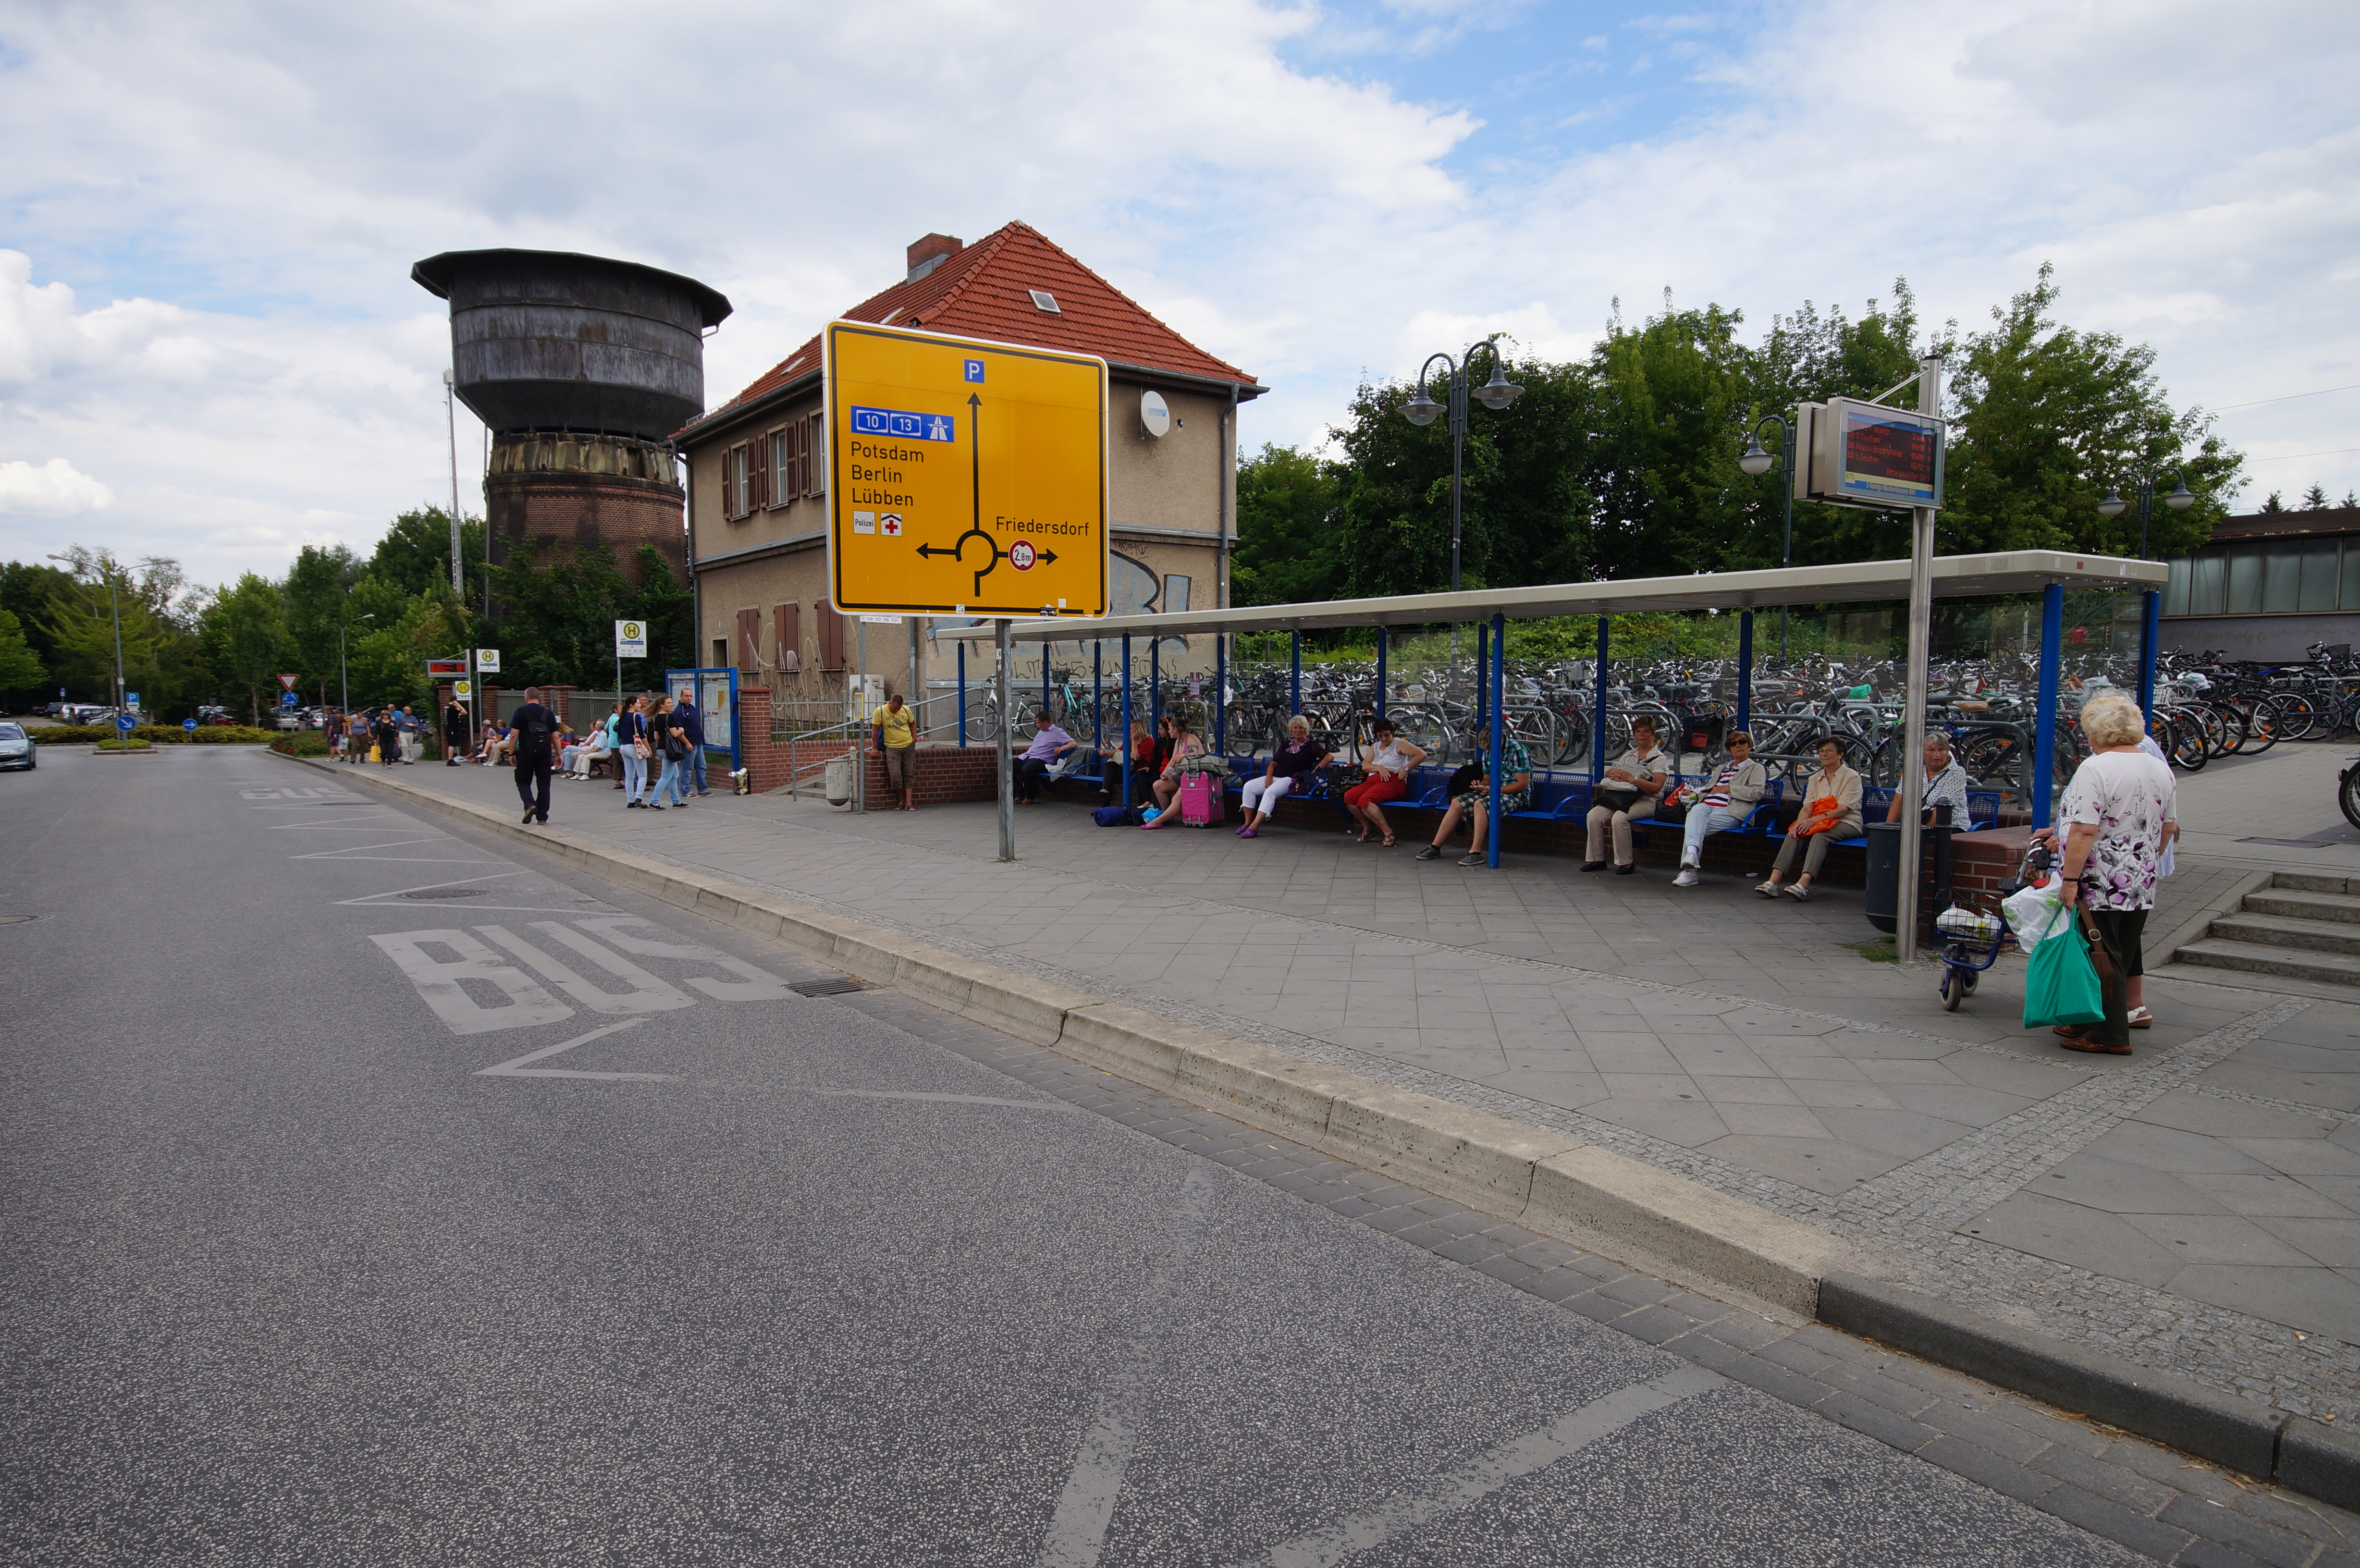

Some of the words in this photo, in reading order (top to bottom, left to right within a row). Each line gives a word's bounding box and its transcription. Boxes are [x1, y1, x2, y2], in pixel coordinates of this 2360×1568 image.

[969, 362, 980, 380] P
[866, 415, 879, 428] 10
[899, 418, 912, 431] 13
[851, 441, 924, 463] Potsdam
[851, 464, 903, 484] Berlin
[852, 487, 914, 507] Lübben
[1883, 483, 1909, 494] Wusterhausen
[855, 518, 874, 527] Polizei
[996, 516, 1090, 536] Friedersdorf
[627, 626, 636, 636] H
[367, 917, 801, 1035] BUS
